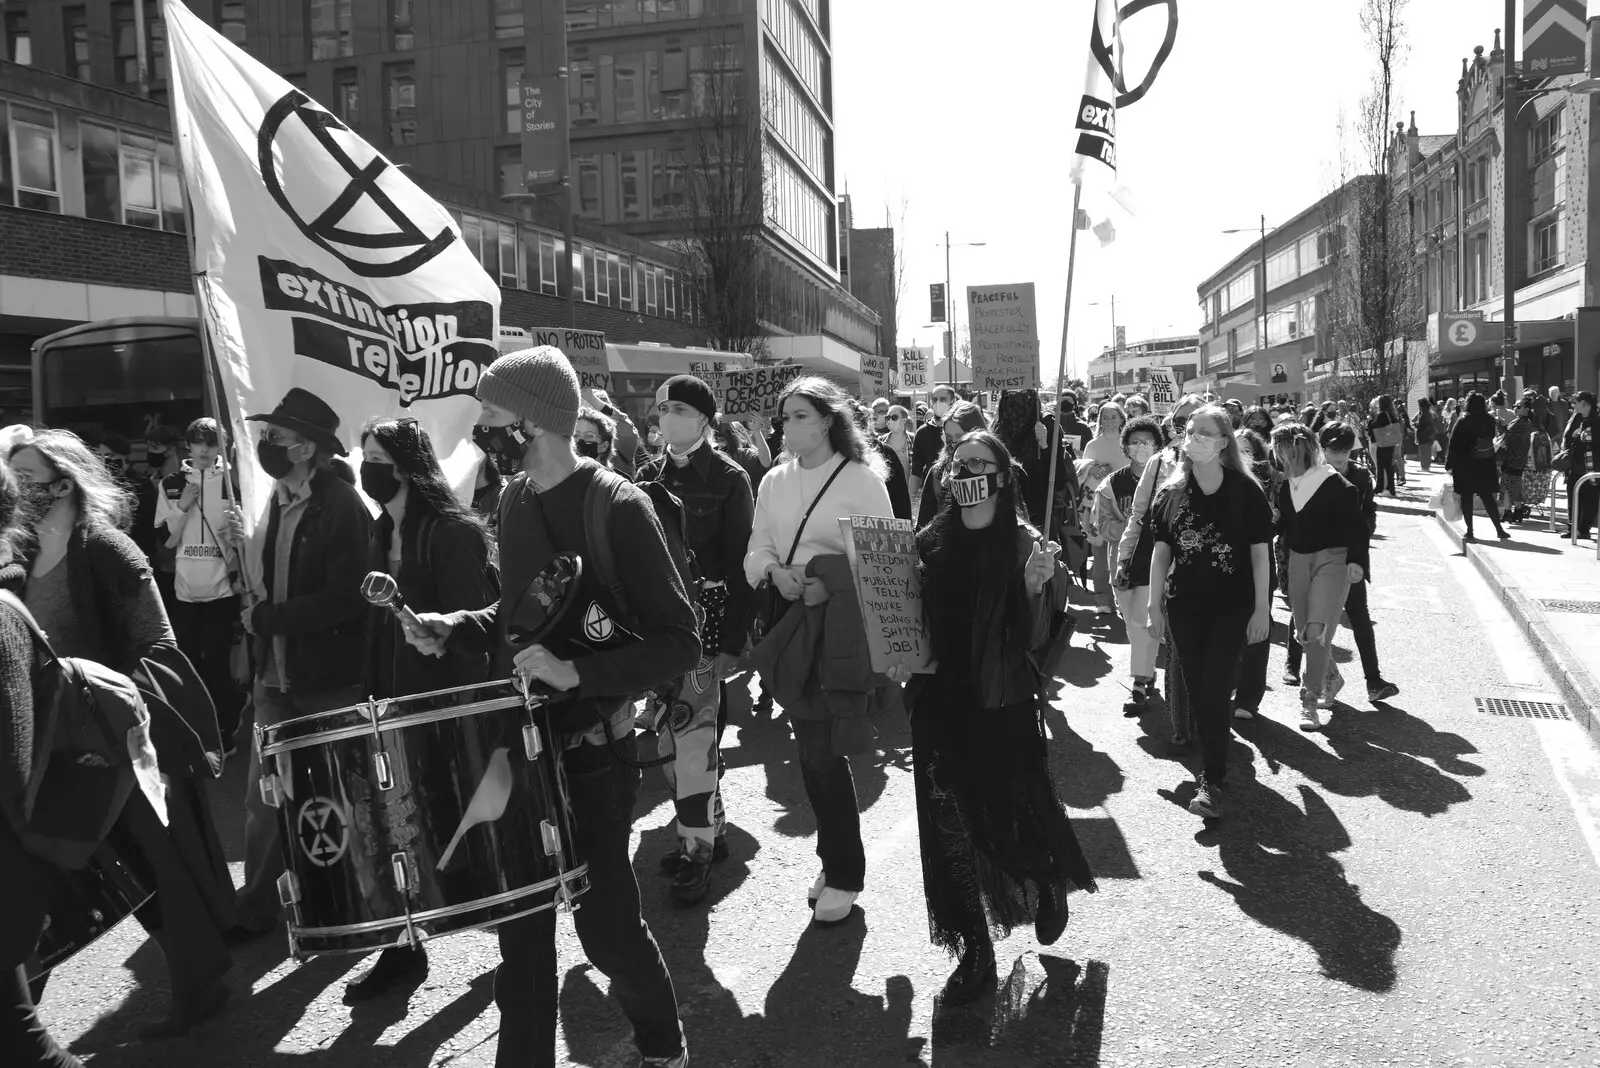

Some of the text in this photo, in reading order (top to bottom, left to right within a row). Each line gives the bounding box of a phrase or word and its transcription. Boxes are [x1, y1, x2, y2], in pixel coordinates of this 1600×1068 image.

[524, 86, 540, 96] The
[524, 98, 542, 108] City
[526, 110, 536, 119] of
[526, 121, 556, 131] Stories
[971, 291, 1019, 304] PEACEFUL
[975, 306, 1025, 320] PROTESTER
[1444, 312, 1481, 320] Poundland
[975, 322, 1030, 336] PEACEFULLY
[536, 331, 604, 350] NO PROTEST
[978, 340, 1032, 350] PROTESTING
[903, 349, 924, 361] KILL
[975, 355, 986, 364] TO
[863, 358, 877, 368] WHO
[903, 362, 925, 372] THE
[347, 336, 488, 402] rebellio
[975, 366, 1029, 378] PEACEFUL
[726, 366, 802, 387] THIS IS WHAT
[904, 373, 926, 387] BILL
[1151, 374, 1172, 384] KILL
[985, 376, 1025, 389] PROTEST
[1152, 384, 1172, 393] THE
[1153, 393, 1176, 403] BILL
[725, 398, 761, 415] LOOKS
[851, 515, 912, 532] BEAT THEM
[861, 553, 910, 566] FREEDOM
[873, 565, 893, 575] TO
[862, 576, 910, 591] PUBLICLY
[873, 587, 900, 598] TELL
[866, 600, 902, 612] YOU'RE
[879, 614, 911, 624] DOING
